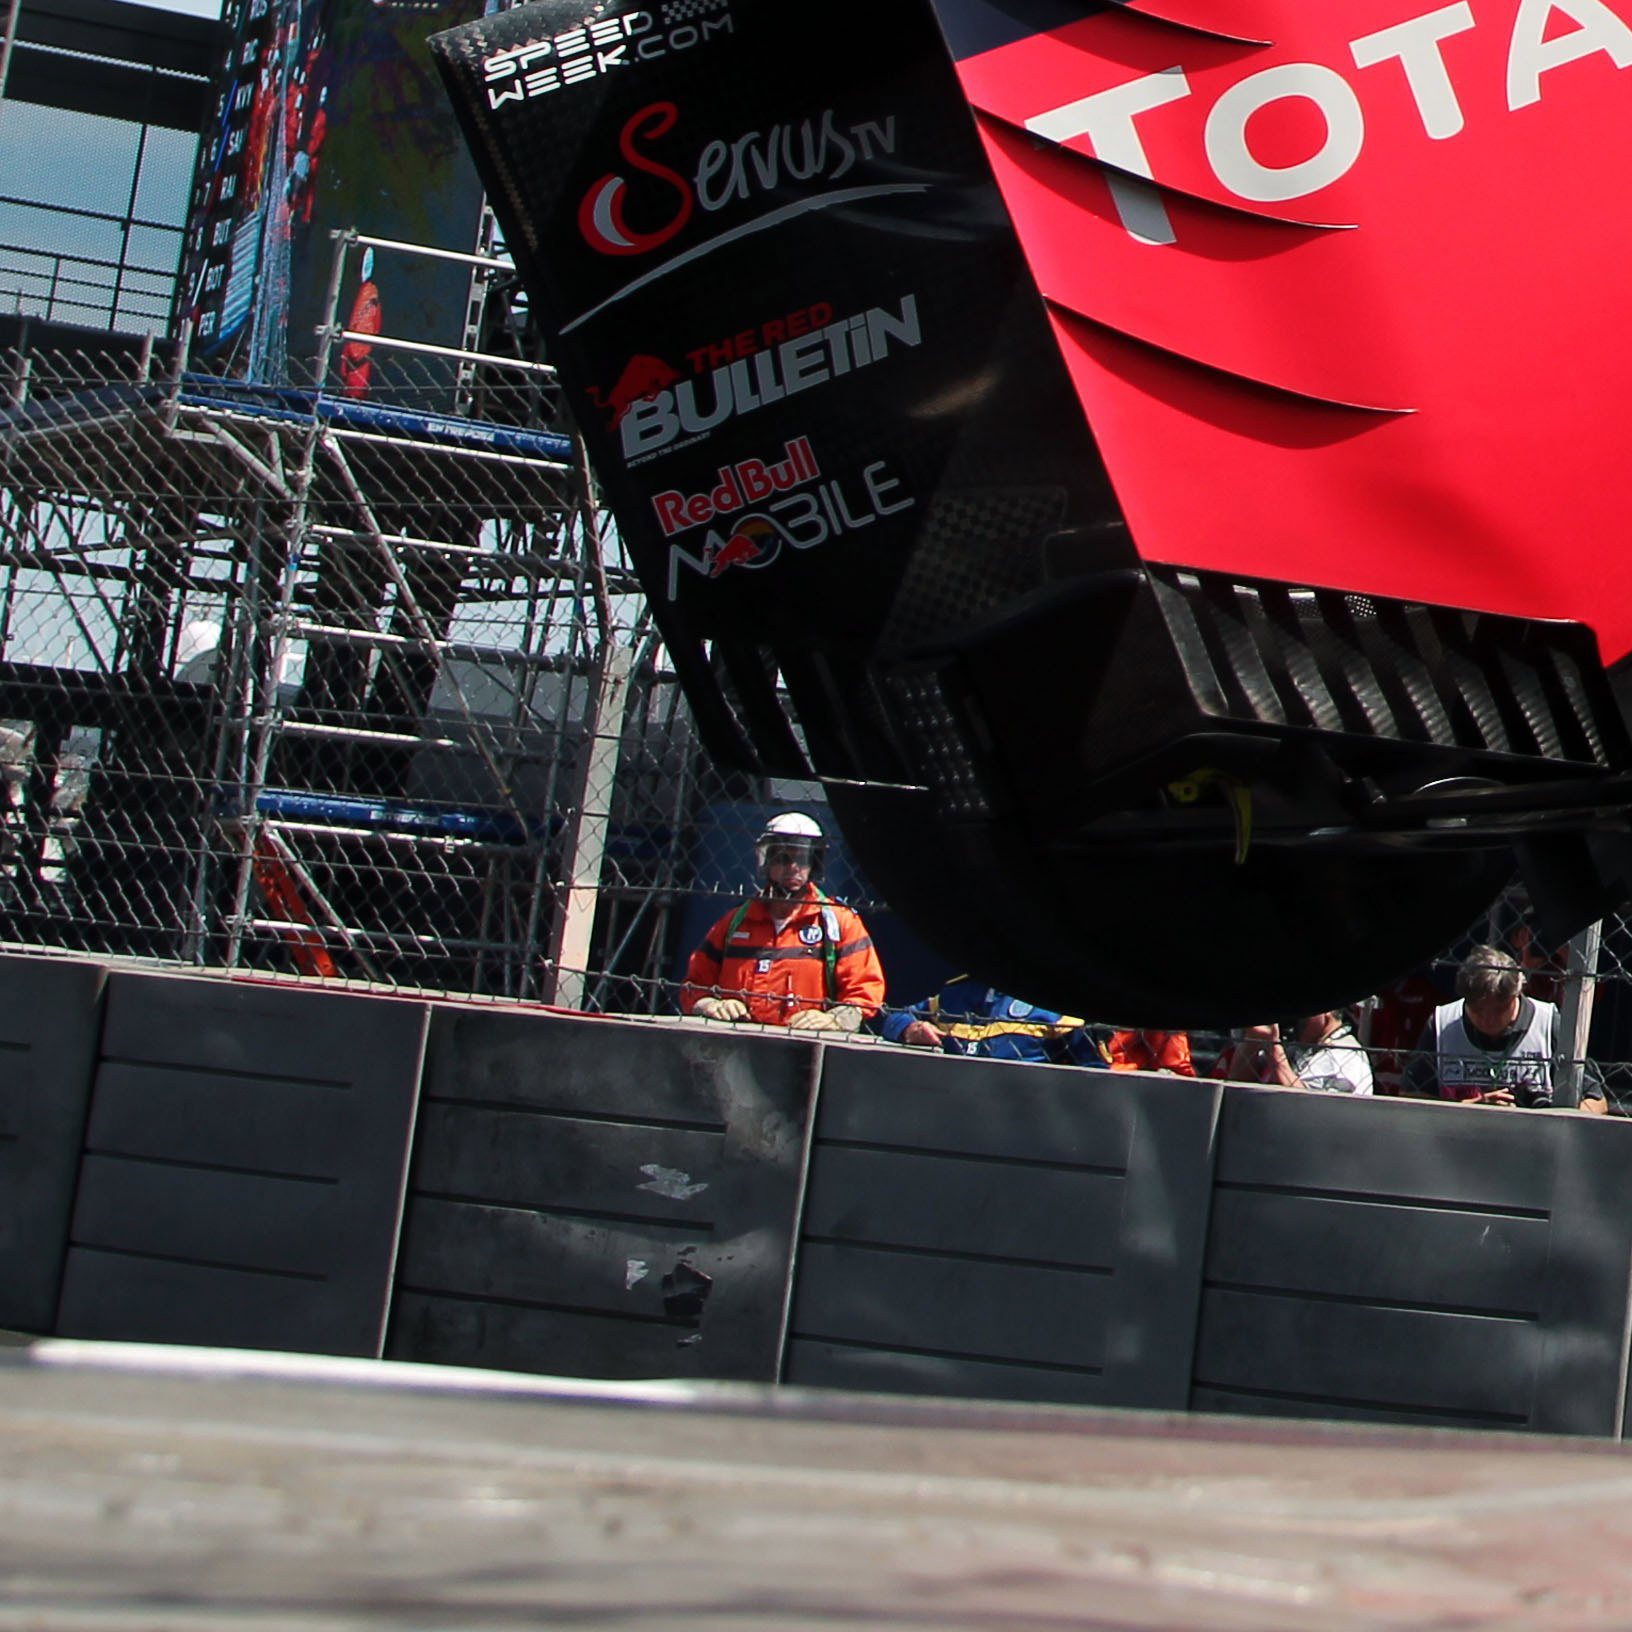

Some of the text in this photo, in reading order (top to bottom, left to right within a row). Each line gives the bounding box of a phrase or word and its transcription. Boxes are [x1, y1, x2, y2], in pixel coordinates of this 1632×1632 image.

[484, 11, 653, 82] SPEED
[687, 302, 834, 374] THE RED
[668, 460, 916, 602] MOBILE
